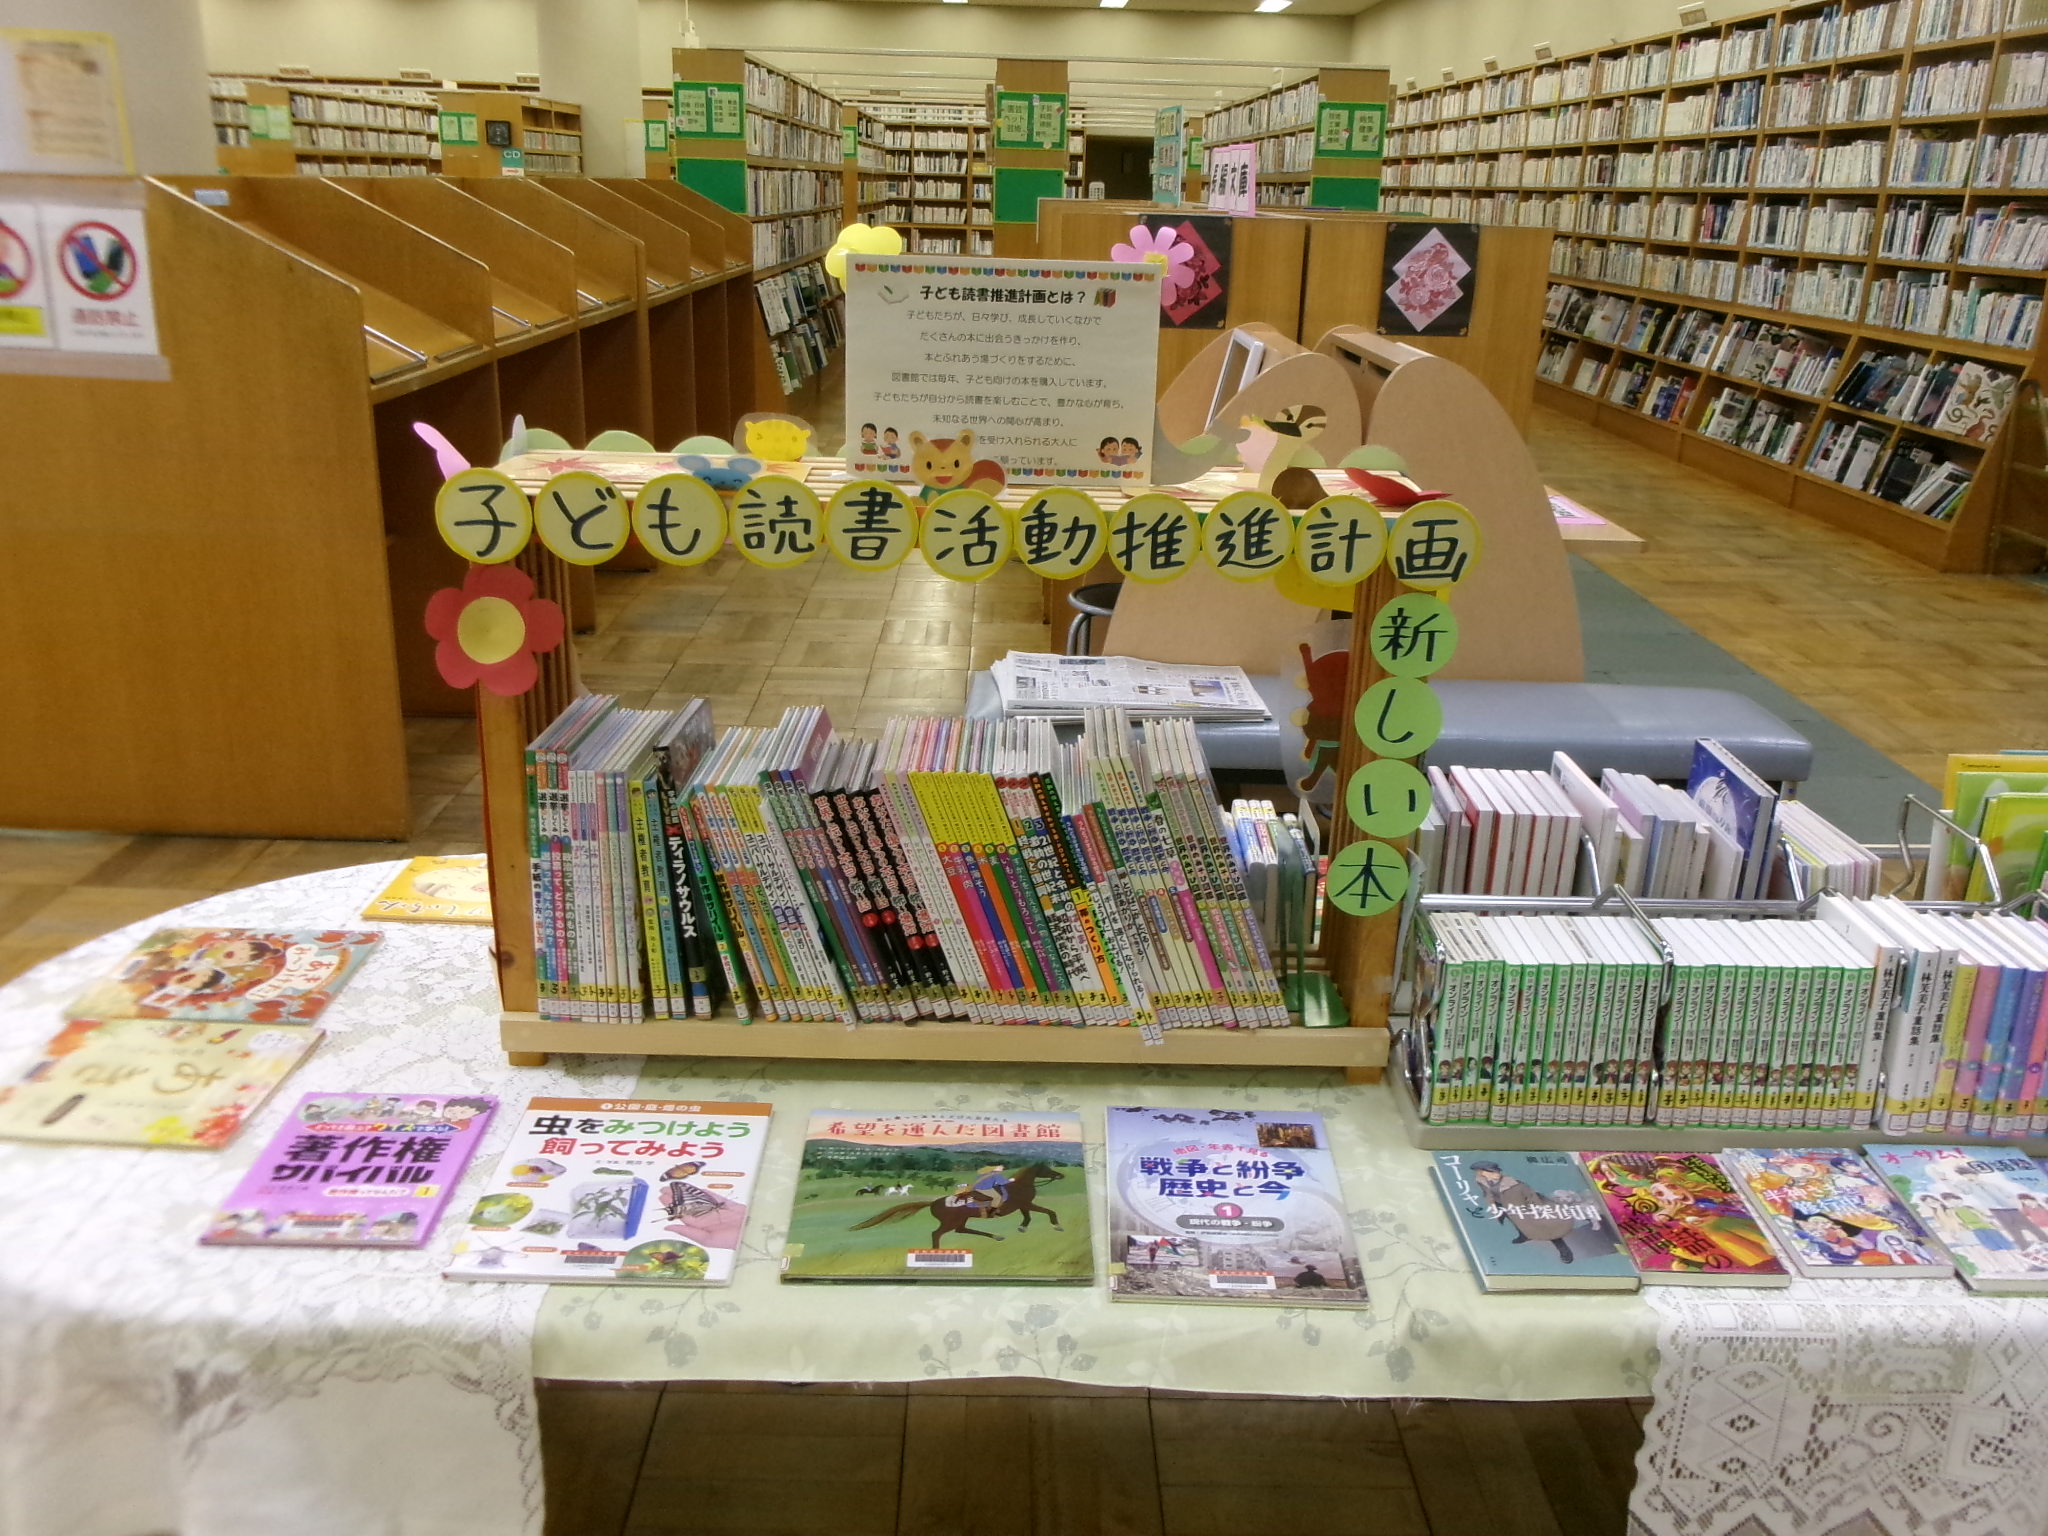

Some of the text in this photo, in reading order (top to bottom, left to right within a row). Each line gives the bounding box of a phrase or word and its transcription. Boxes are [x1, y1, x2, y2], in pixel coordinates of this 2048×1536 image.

[503, 150, 521, 158] CD
[919, 285, 1086, 304] 子ども読書推進計画とは？
[453, 483, 1468, 583] 子ども読書活動推進計画
[1332, 606, 1450, 909] 新しい本
[667, 837, 697, 938] ティラノサウルス
[529, 1114, 752, 1138] 虫をみつけよう
[827, 1121, 1062, 1139] 希望を運んだ図書館
[285, 1134, 452, 1164] 著作権
[539, 1137, 725, 1159] 飼ってみよう
[271, 1164, 435, 1184] サバイバル
[1139, 1156, 1306, 1181] 戦争と紛争
[1158, 1178, 1291, 1201] 歴史と今
[1222, 1205, 1233, 1217] 1
